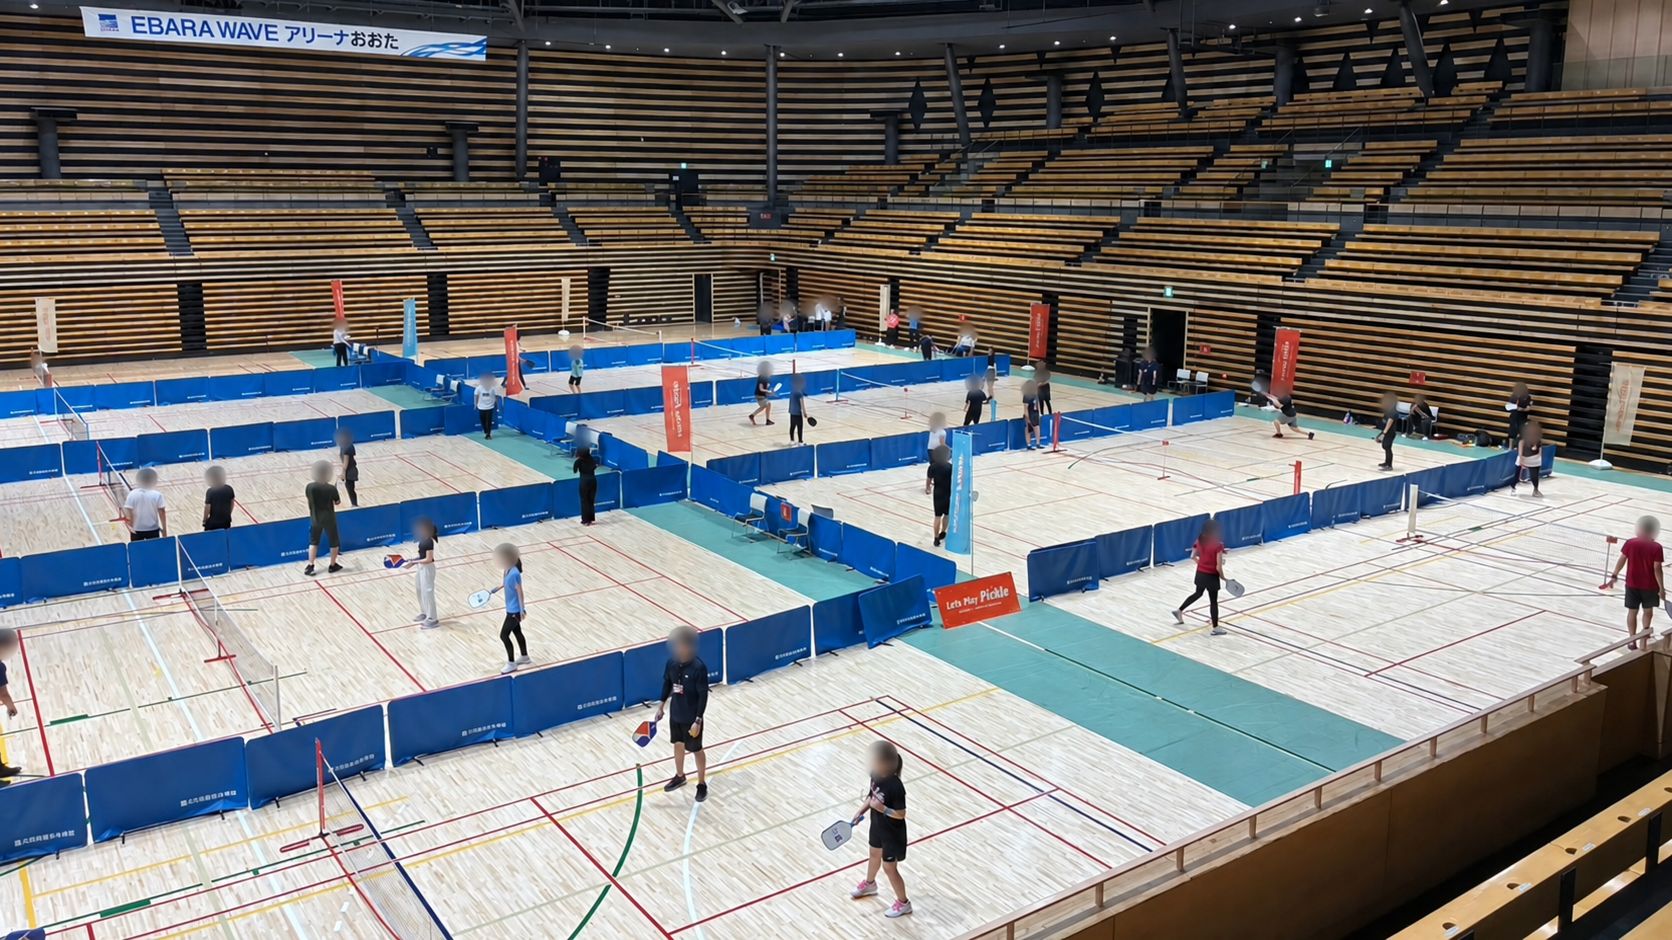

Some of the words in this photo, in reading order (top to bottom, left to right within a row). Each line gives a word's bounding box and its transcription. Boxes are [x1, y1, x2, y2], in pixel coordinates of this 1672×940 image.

[131, 15, 215, 38] EBARA
[216, 21, 279, 42] WAVE
[284, 25, 399, 49] アリーナおおた
[980, 585, 1009, 603] Pickle
